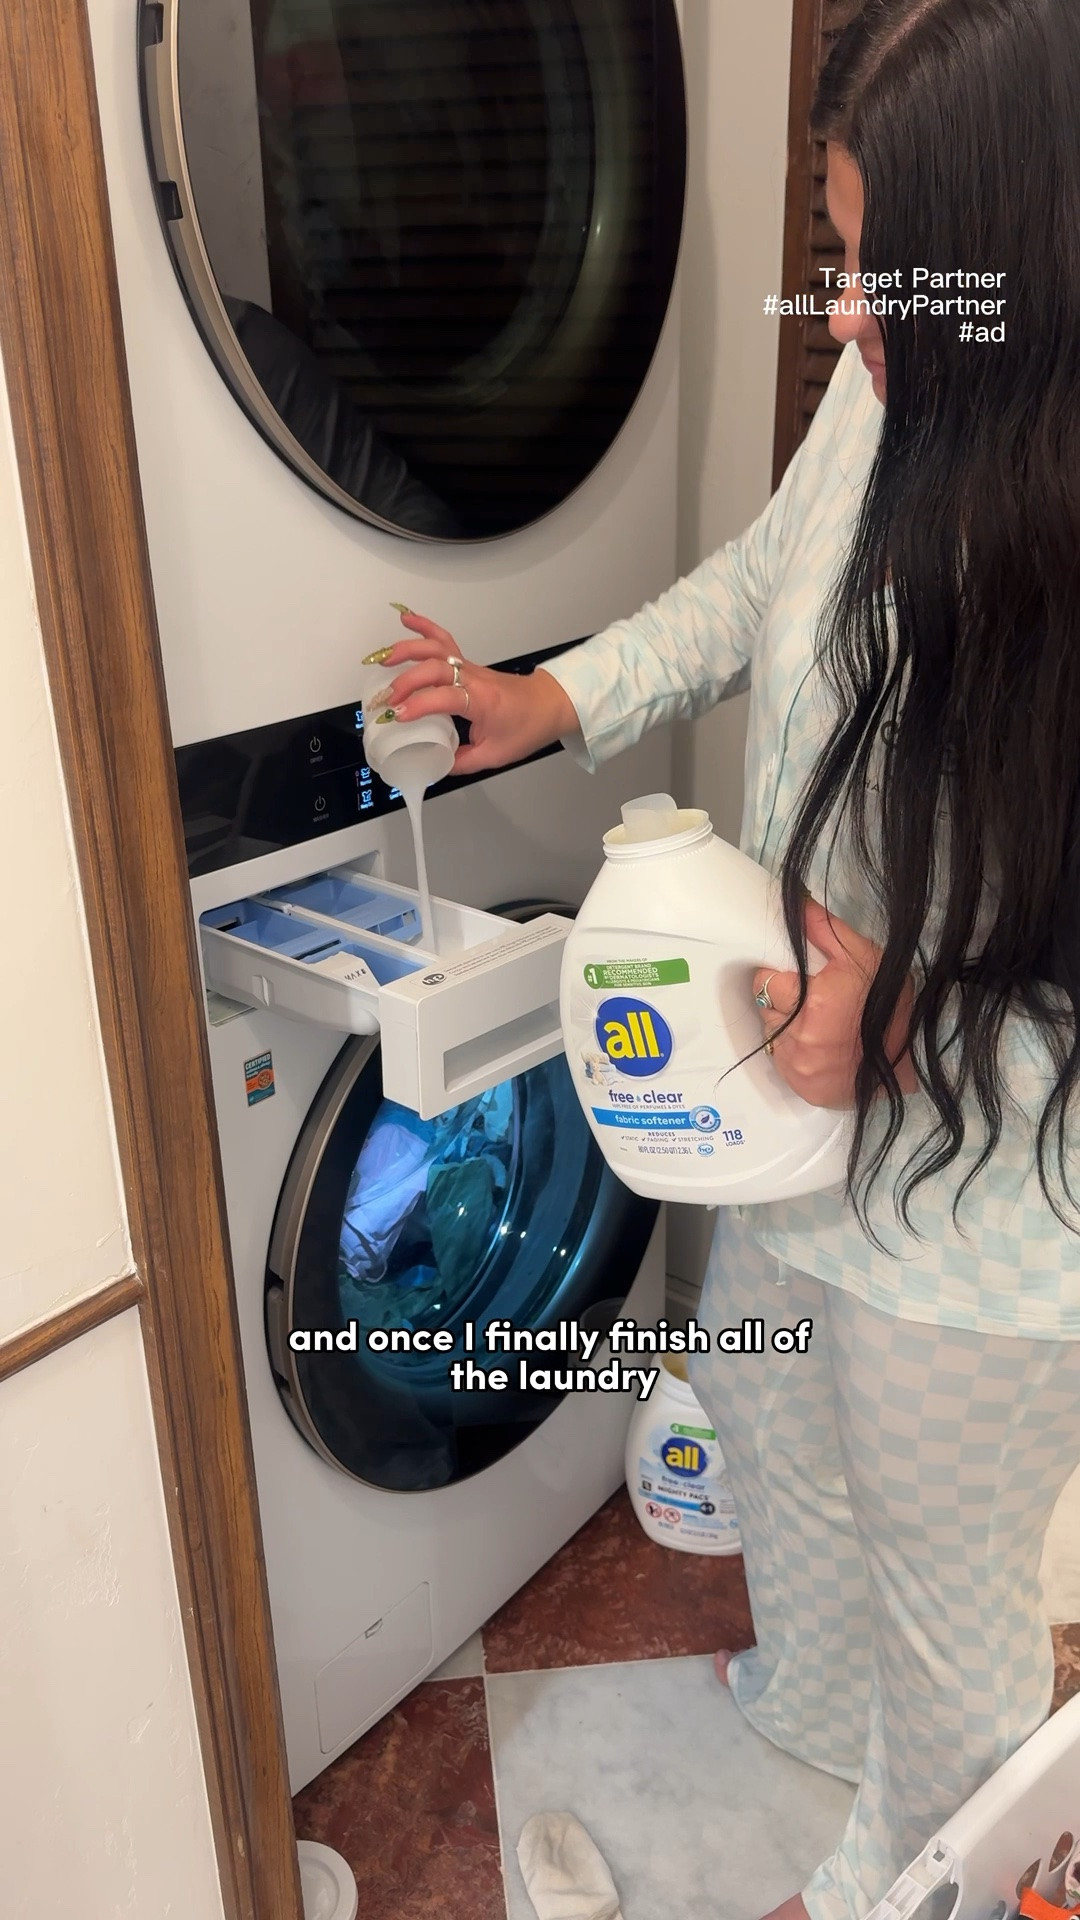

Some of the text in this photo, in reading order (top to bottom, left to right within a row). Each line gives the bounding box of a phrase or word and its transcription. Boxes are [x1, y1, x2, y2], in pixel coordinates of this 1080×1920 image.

[603, 966, 658, 976] RECOMMENDED
[604, 1012, 660, 1059] all
[608, 1089, 683, 1104] free clear
[615, 1115, 686, 1125] fabric softener
[677, 1135, 715, 1143] STRETCHING
[722, 1129, 743, 1141] 118
[665, 1445, 699, 1471] all
[657, 1485, 709, 1501] MIGHTY PACS
